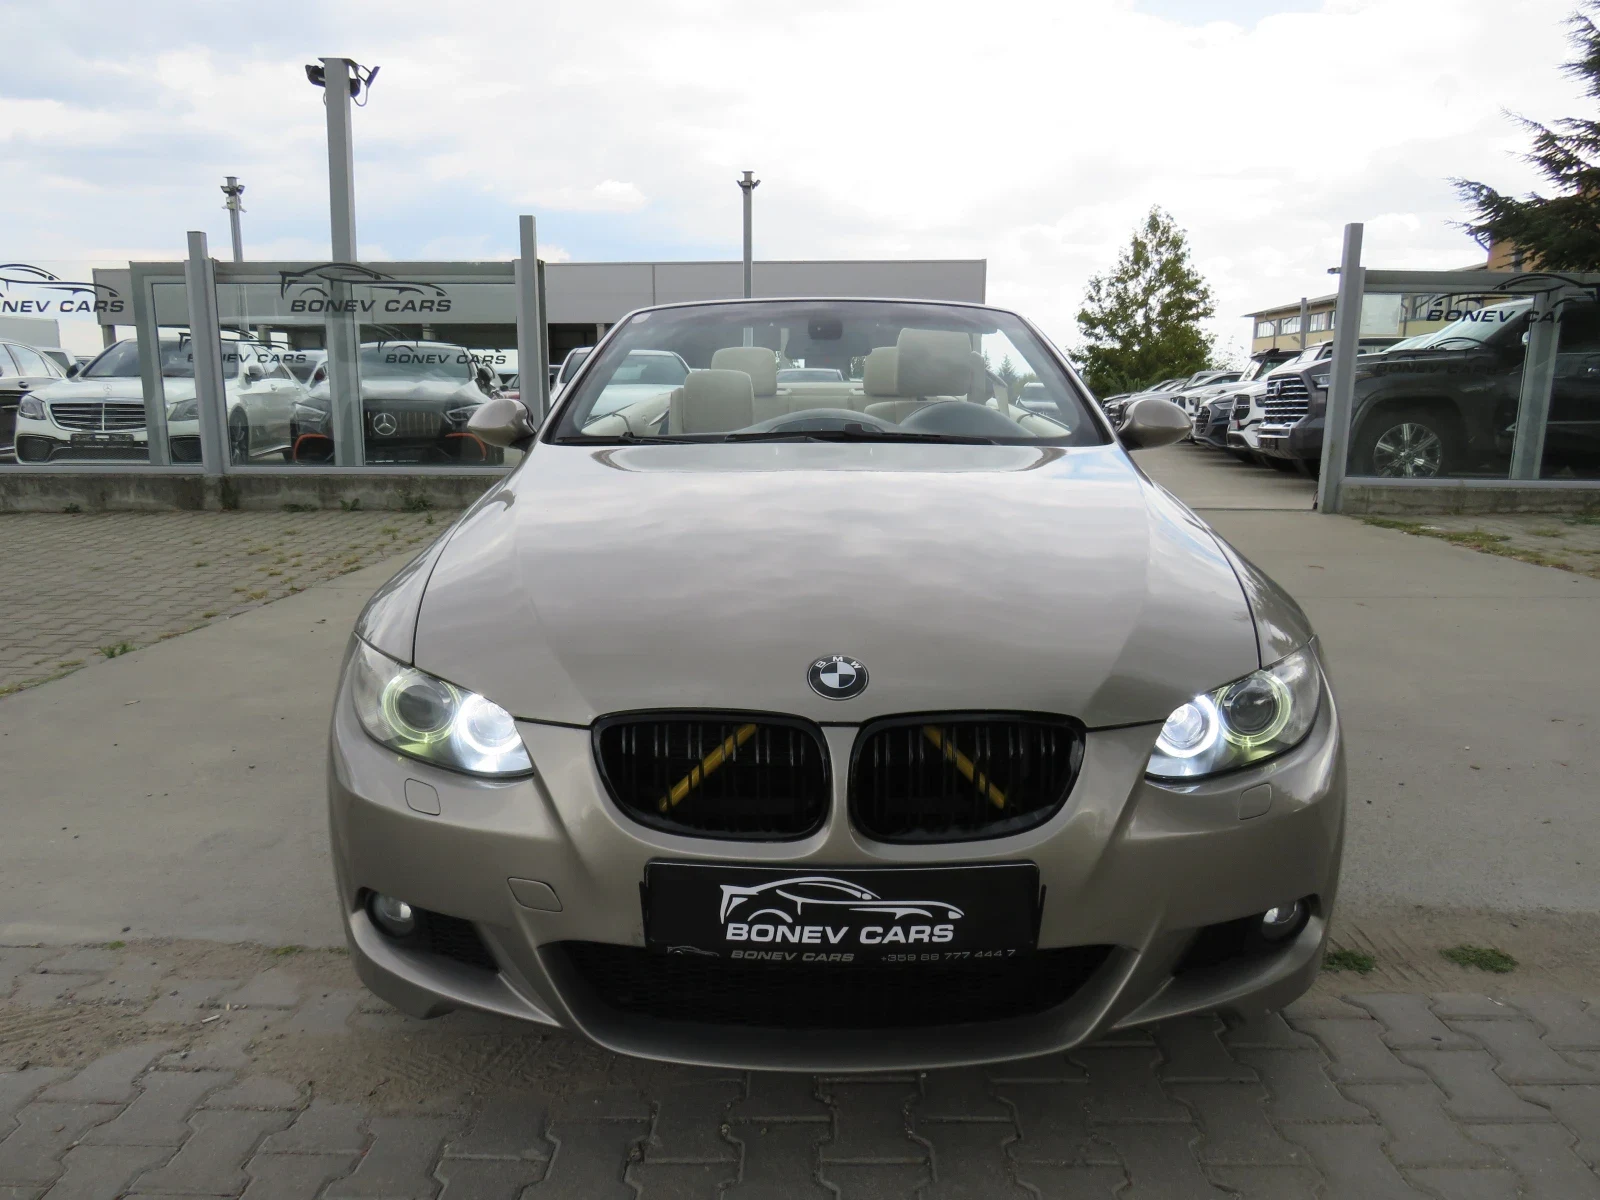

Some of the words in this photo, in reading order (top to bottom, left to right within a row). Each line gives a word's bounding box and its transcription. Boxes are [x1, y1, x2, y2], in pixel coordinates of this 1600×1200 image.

[1, 300, 51, 313] NEV
[59, 300, 125, 313] CARS
[290, 299, 377, 313] BONEV
[384, 299, 452, 313] CARS
[1426, 309, 1516, 322] BONEV
[257, 353, 307, 364] CARS
[385, 353, 450, 364] BONEV
[456, 354, 507, 365] CARS
[815, 656, 862, 669] BMW
[725, 922, 850, 945] BONEV
[859, 923, 955, 945] CARS
[730, 949, 799, 962] BONEV
[801, 951, 855, 963] CARS
[944, 951, 971, 961] 777
[974, 949, 1003, 958] 444
[1007, 949, 1017, 957] 7
